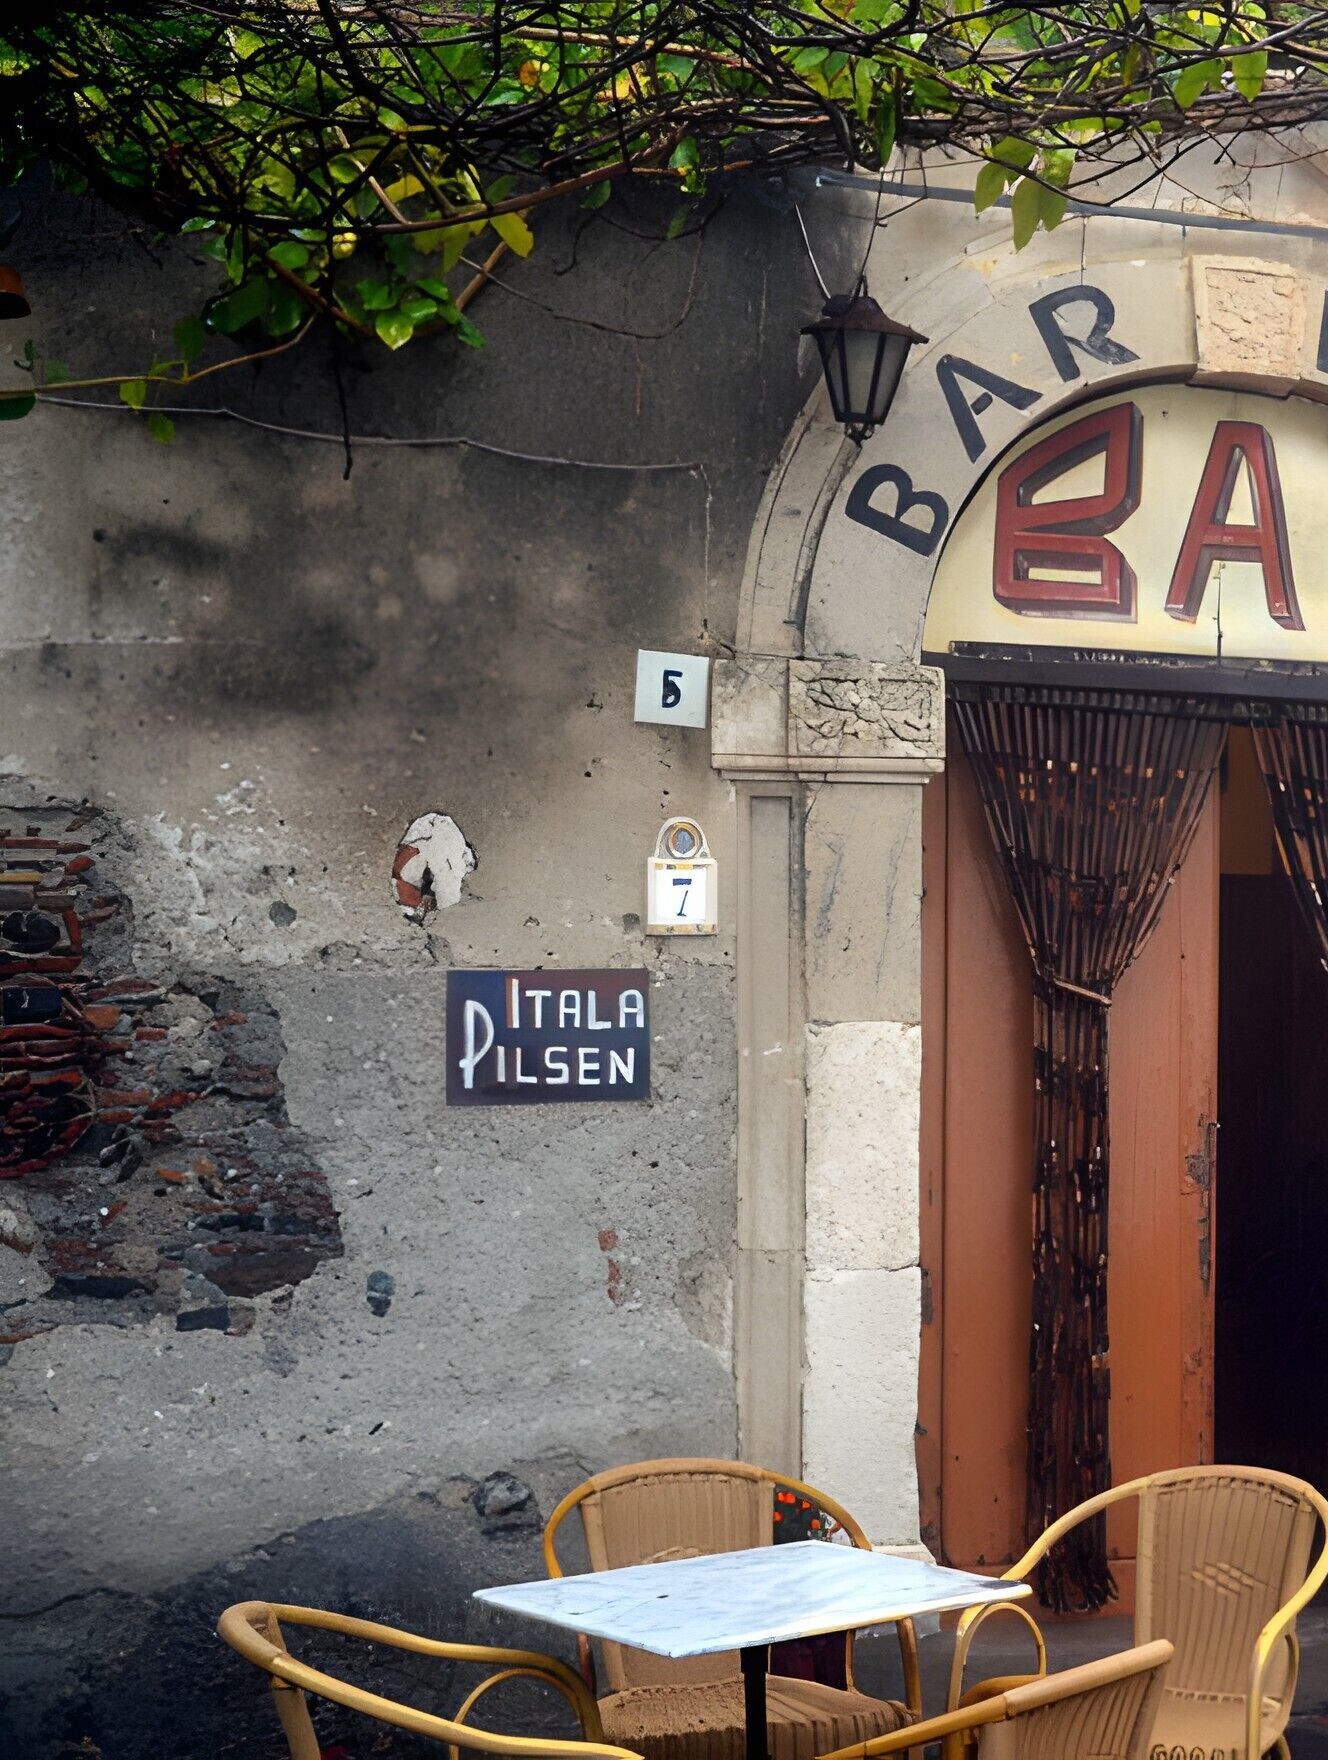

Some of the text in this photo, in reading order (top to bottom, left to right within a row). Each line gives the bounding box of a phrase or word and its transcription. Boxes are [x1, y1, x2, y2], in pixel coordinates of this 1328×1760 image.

[845, 285, 1140, 557] BAR
[459, 1000, 635, 1089] PILSEN
[511, 978, 644, 1029] ITALA
